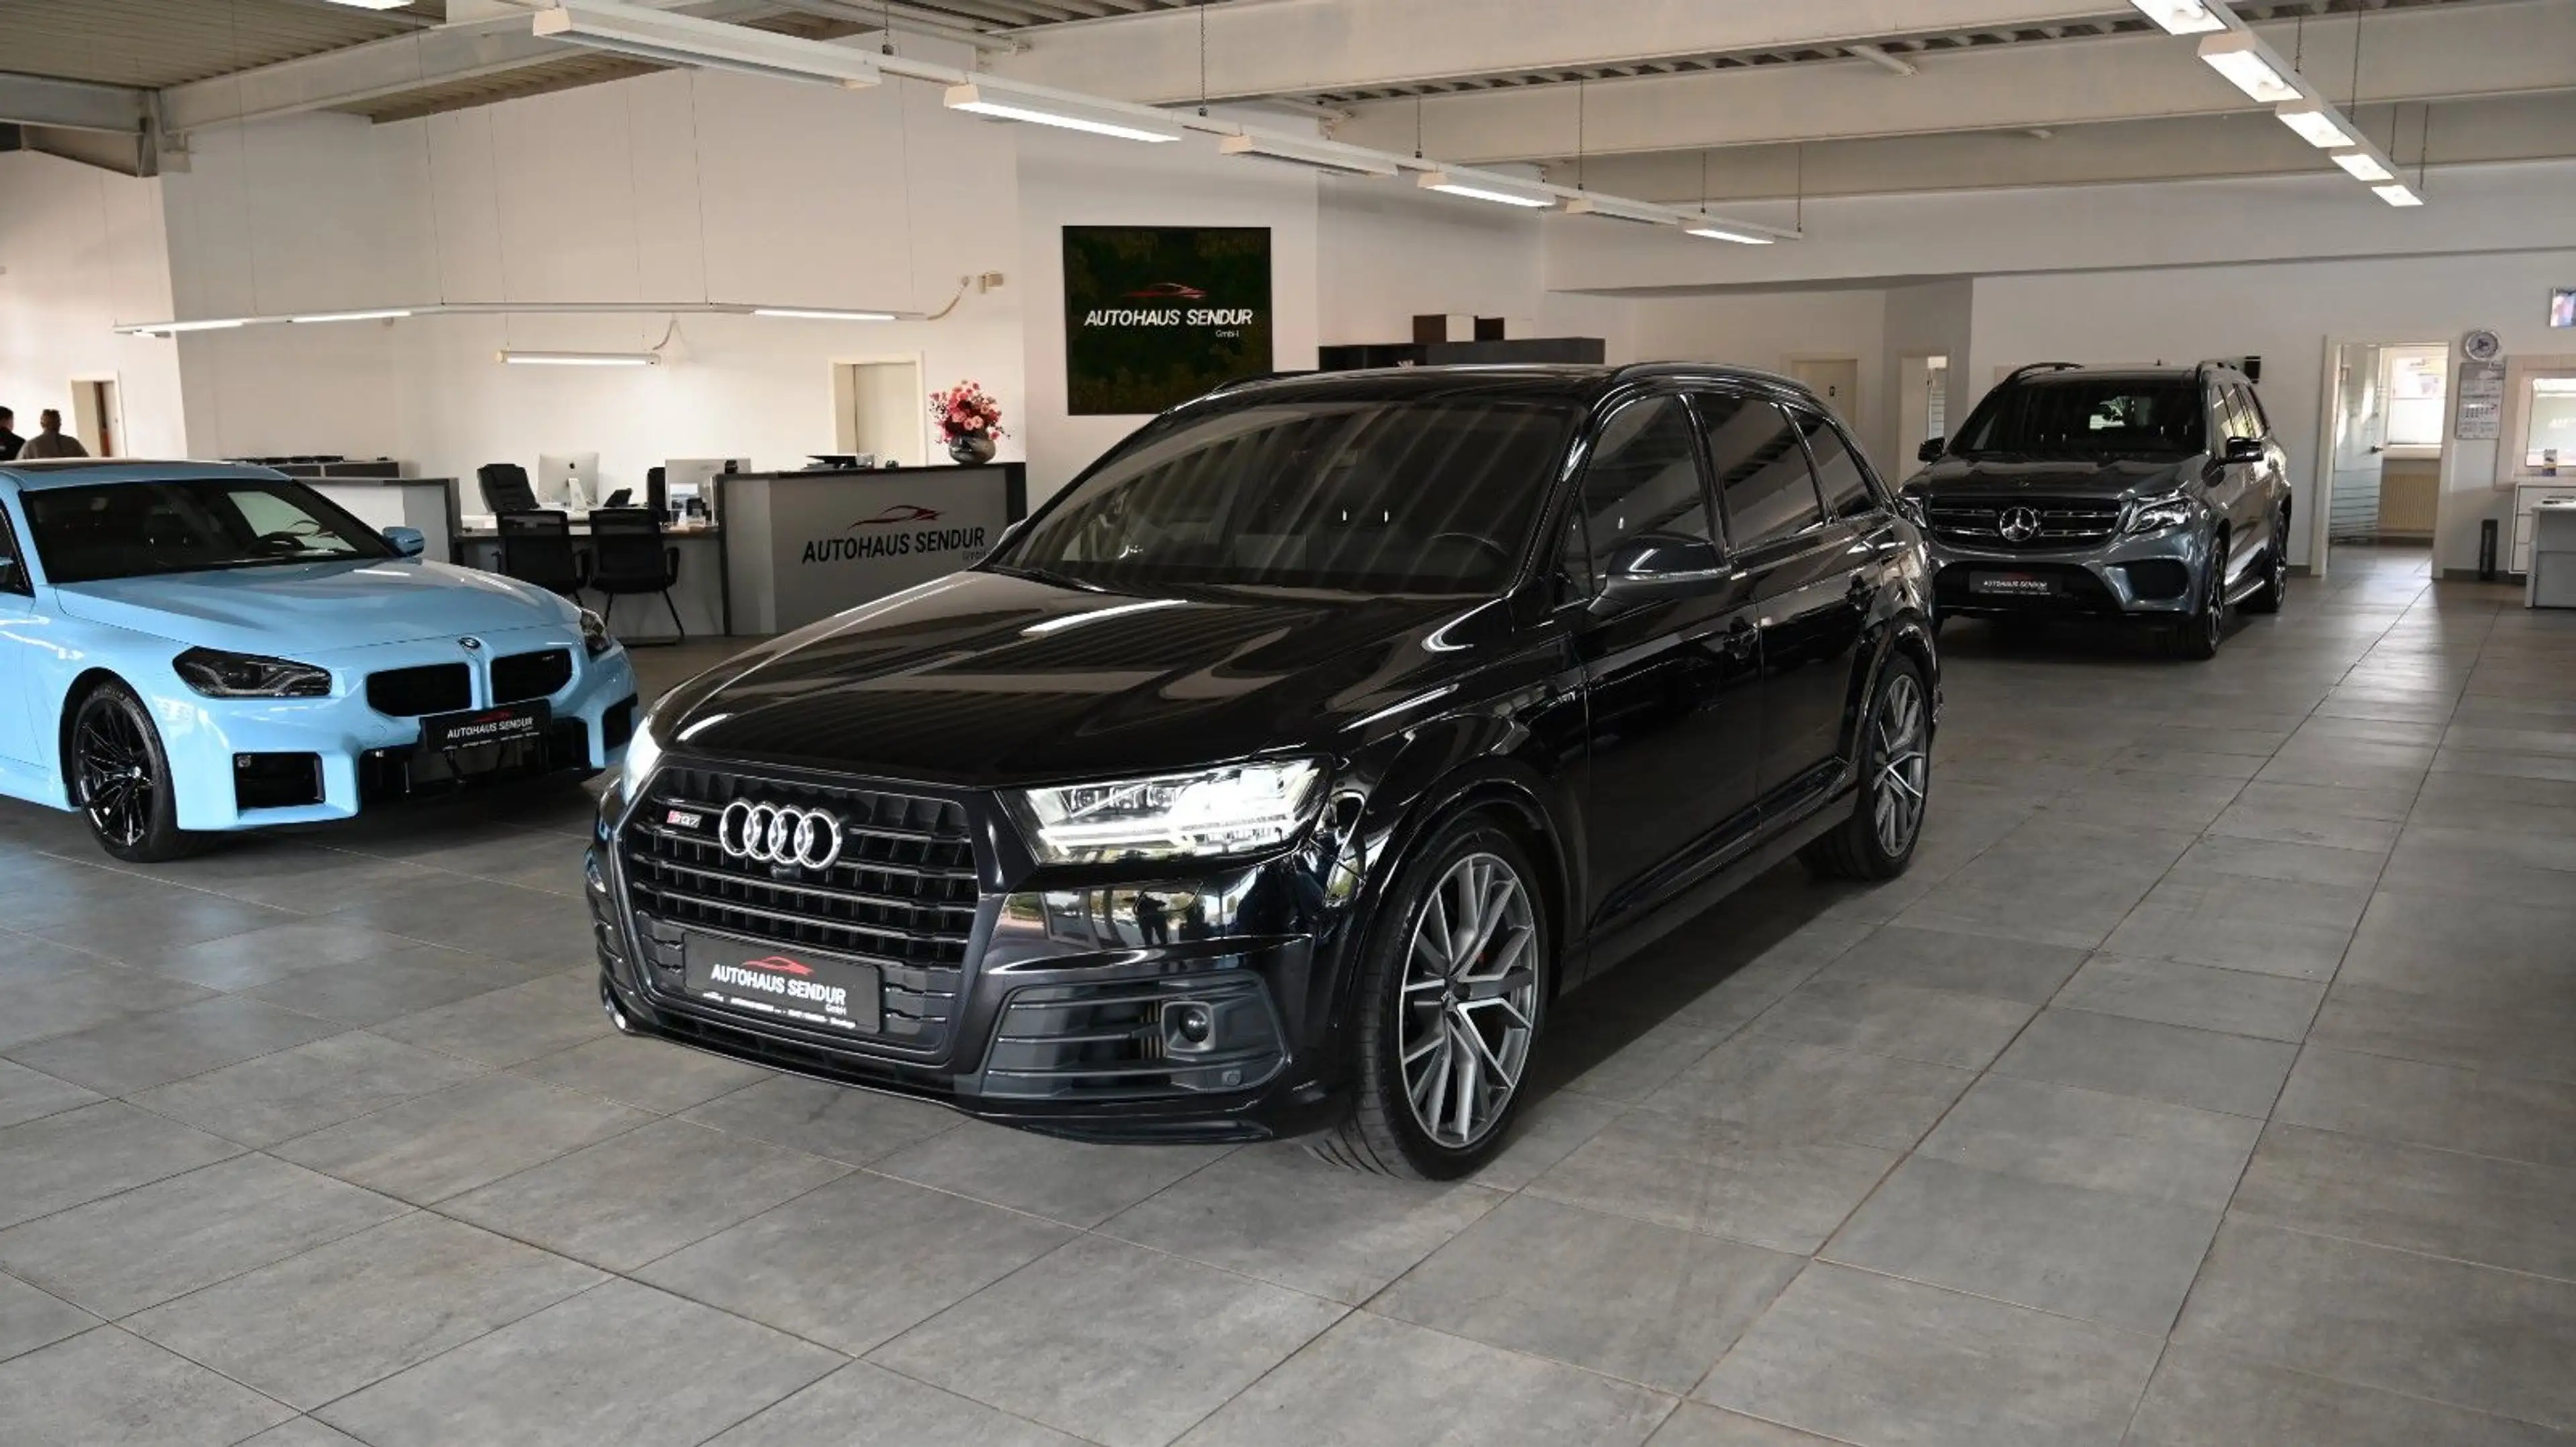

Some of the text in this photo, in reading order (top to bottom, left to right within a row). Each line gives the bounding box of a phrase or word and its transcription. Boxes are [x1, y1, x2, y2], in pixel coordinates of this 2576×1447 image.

[1084, 309, 1253, 326] AUTOHAUS SENDUR
[802, 527, 985, 565] AUTOHAUS SENDUR
[447, 716, 534, 739] AUTOHAUS SENDUR
[668, 811, 700, 828] SQ7
[710, 963, 847, 1006] AUTOHAUS SENDUR
